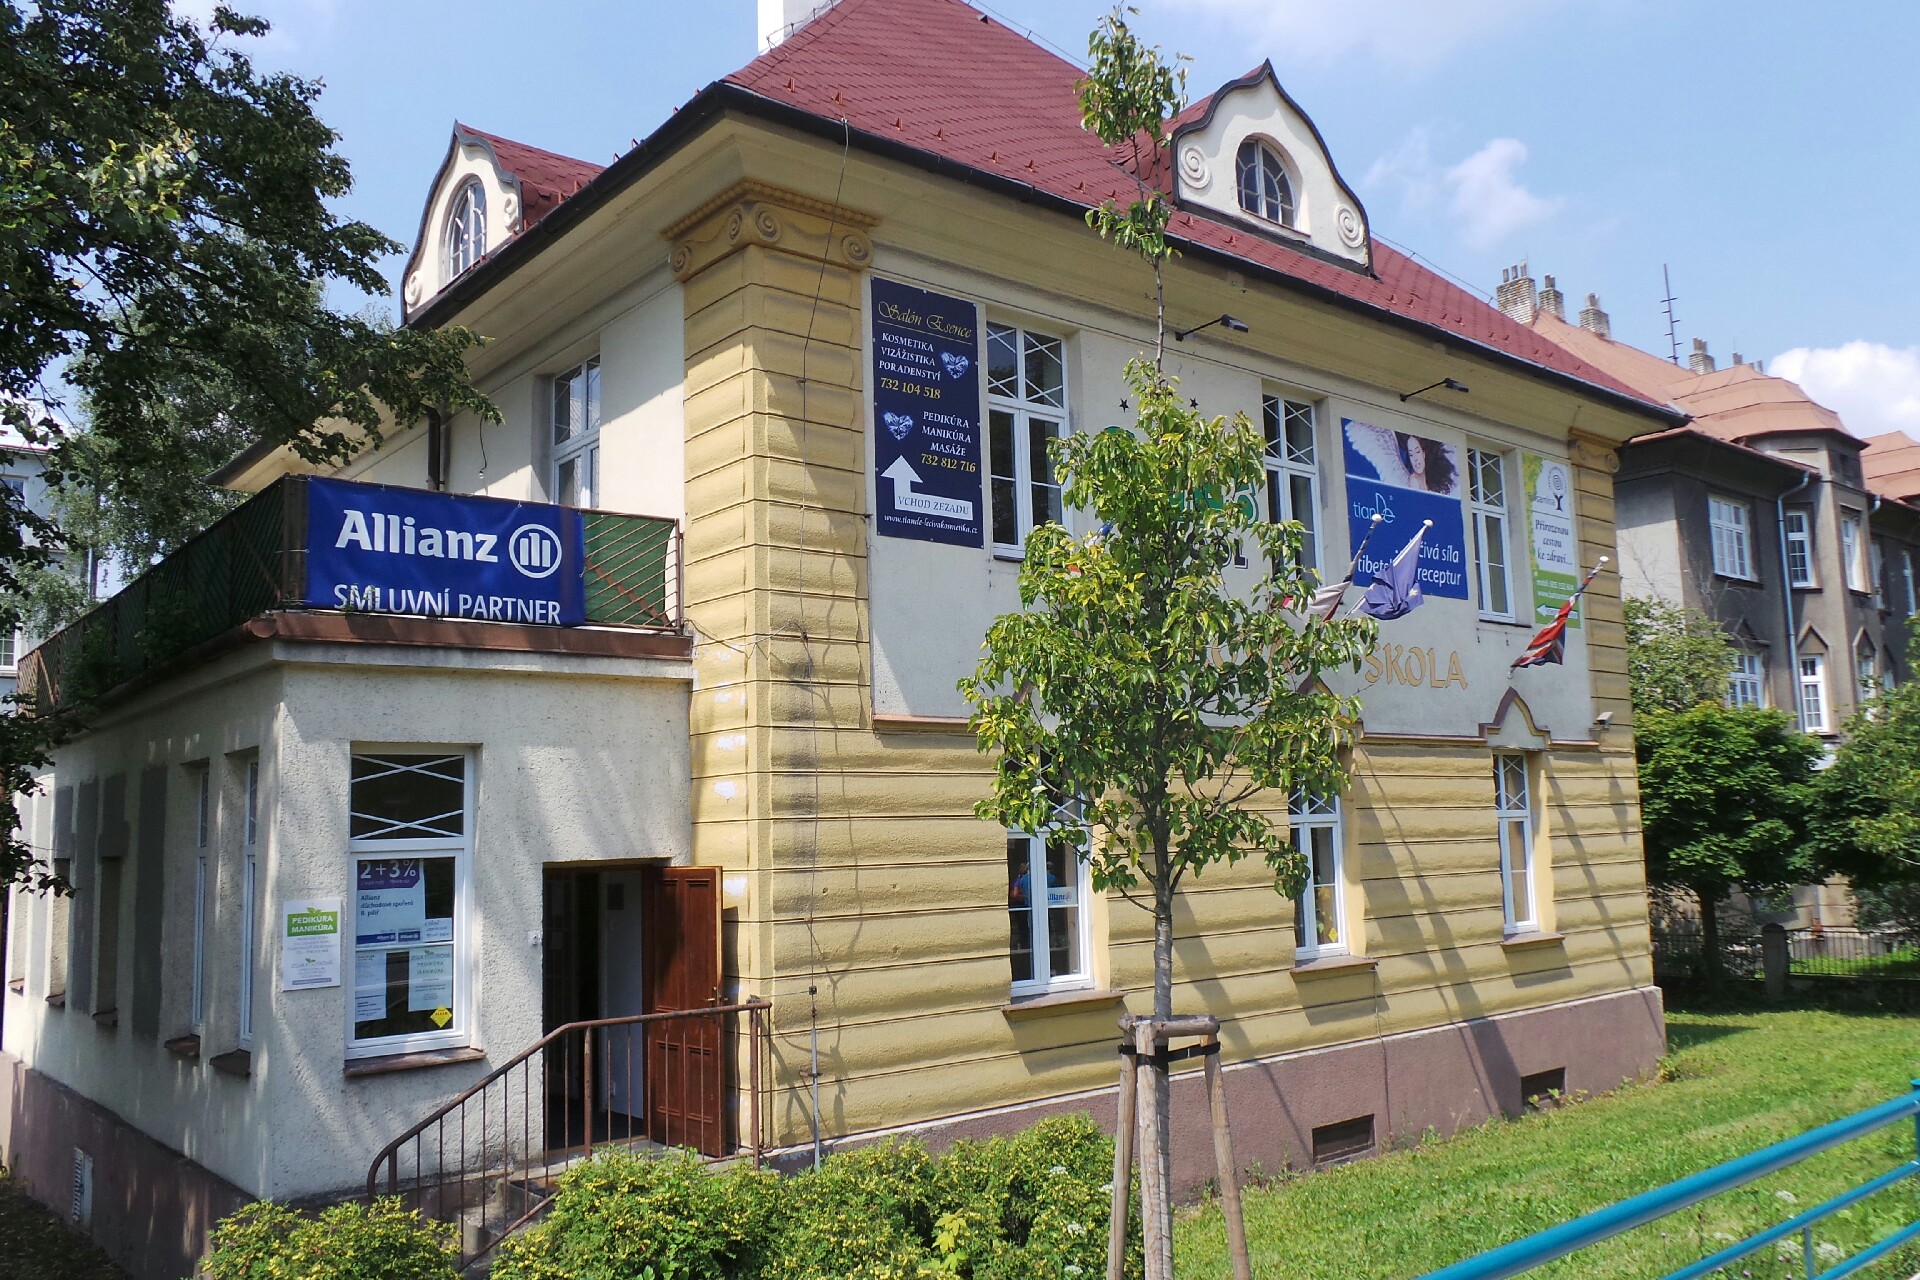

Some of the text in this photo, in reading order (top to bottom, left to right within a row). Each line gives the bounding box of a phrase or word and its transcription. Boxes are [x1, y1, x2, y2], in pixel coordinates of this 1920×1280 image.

[878, 301, 972, 338] Salón Esence
[882, 332, 934, 352] KOSMETIKA
[881, 346, 936, 366] VIZÁŽISTIKA
[879, 360, 941, 381] PORADENSTVÍ
[880, 377, 941, 399] 732 104 518
[923, 410, 970, 428] PEDIKÚRA
[921, 425, 972, 443] MANIKÚRA
[930, 442, 966, 457] MASÁŽE
[921, 453, 976, 473] 732 812 716
[898, 496, 970, 515] VCHOD ZEZADU
[335, 509, 499, 563] Allianz
[1543, 537, 1562, 549] cestou
[1441, 544, 1459, 563] síla
[1537, 548, 1545, 560] ke
[1417, 567, 1461, 588] receptur
[333, 583, 561, 626] SMLUVNÍ PARTNER
[291, 923, 334, 934] MANIKÚRA
[292, 915, 333, 925] PEDIKÚRA
